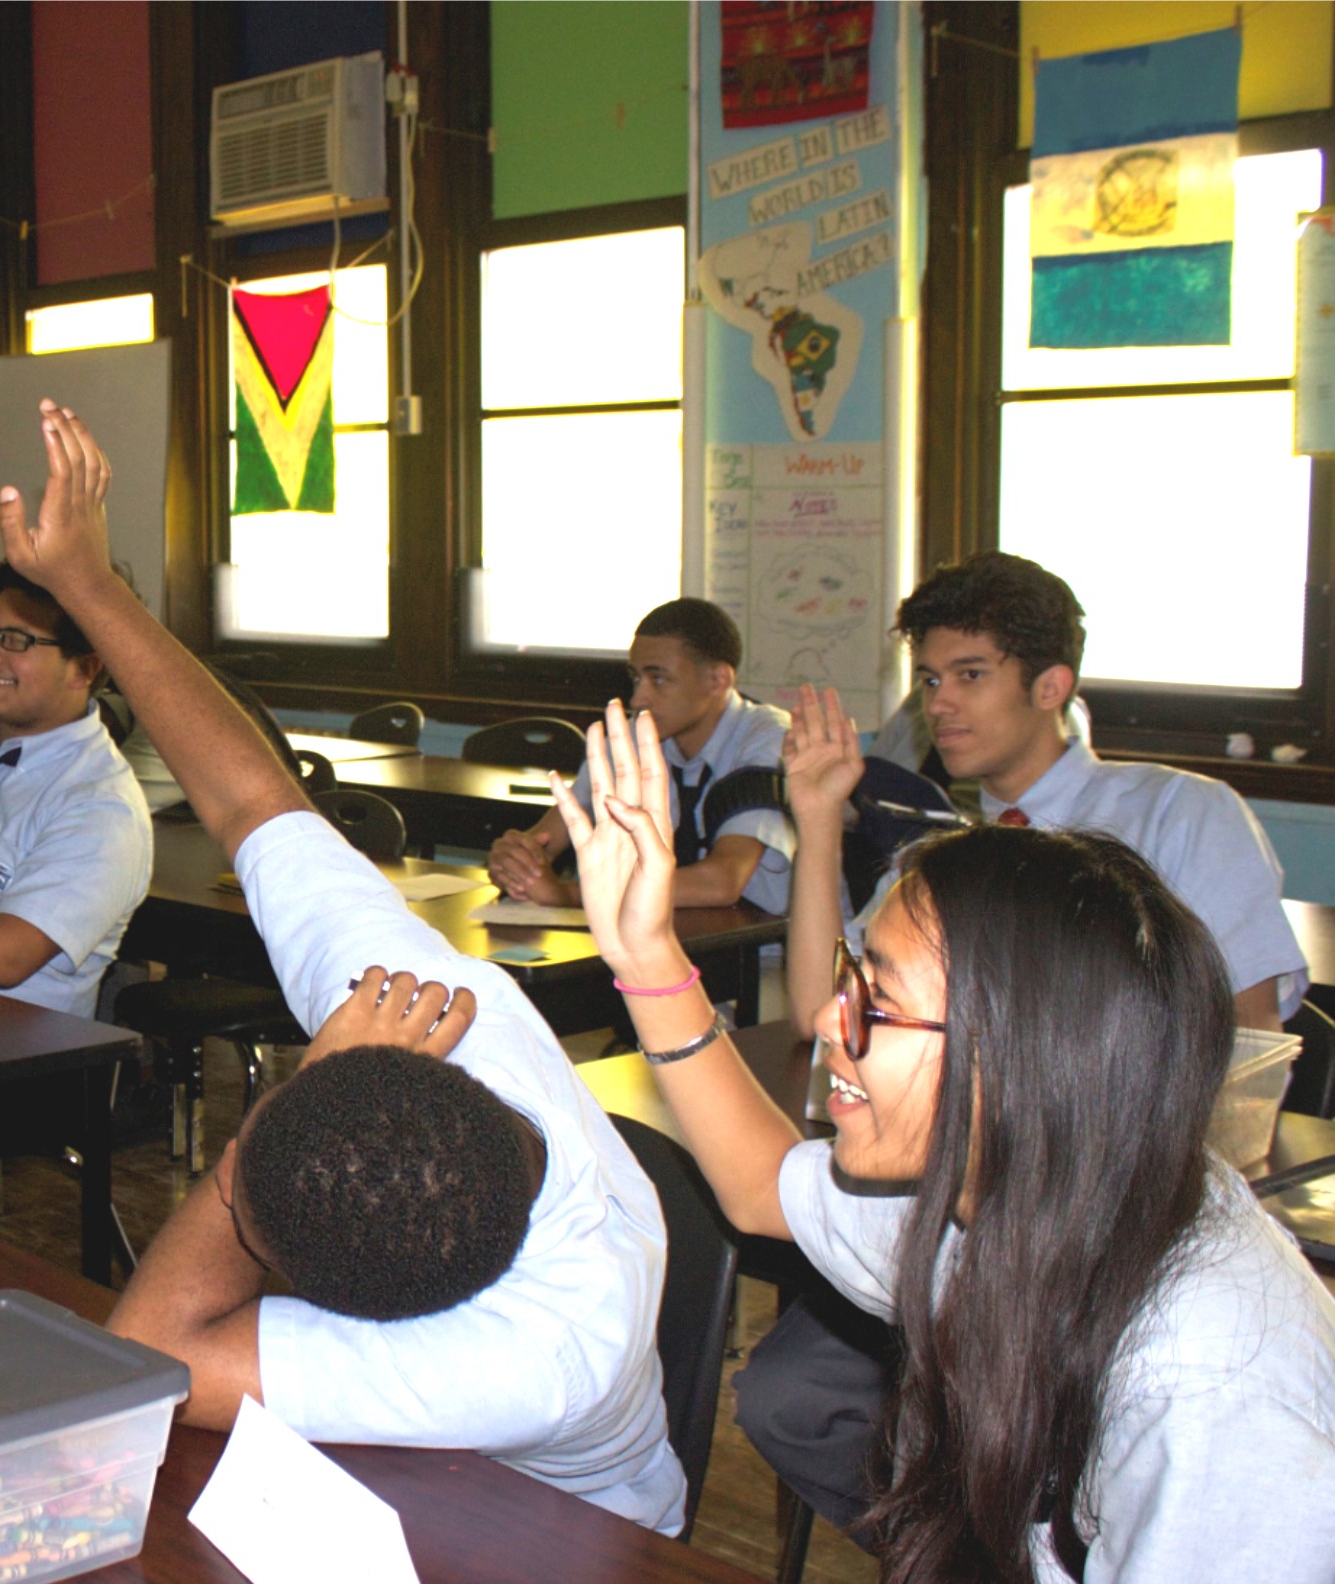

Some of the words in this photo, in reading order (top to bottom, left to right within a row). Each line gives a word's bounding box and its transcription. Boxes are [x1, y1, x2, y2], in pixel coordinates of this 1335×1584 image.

[710, 145, 794, 192] WHERE
[800, 133, 830, 162] IN
[837, 109, 886, 148] THE
[750, 177, 824, 224] WORLD
[829, 165, 857, 195] IS
[818, 191, 891, 240] LATIN
[796, 232, 891, 297] AMERICA?
